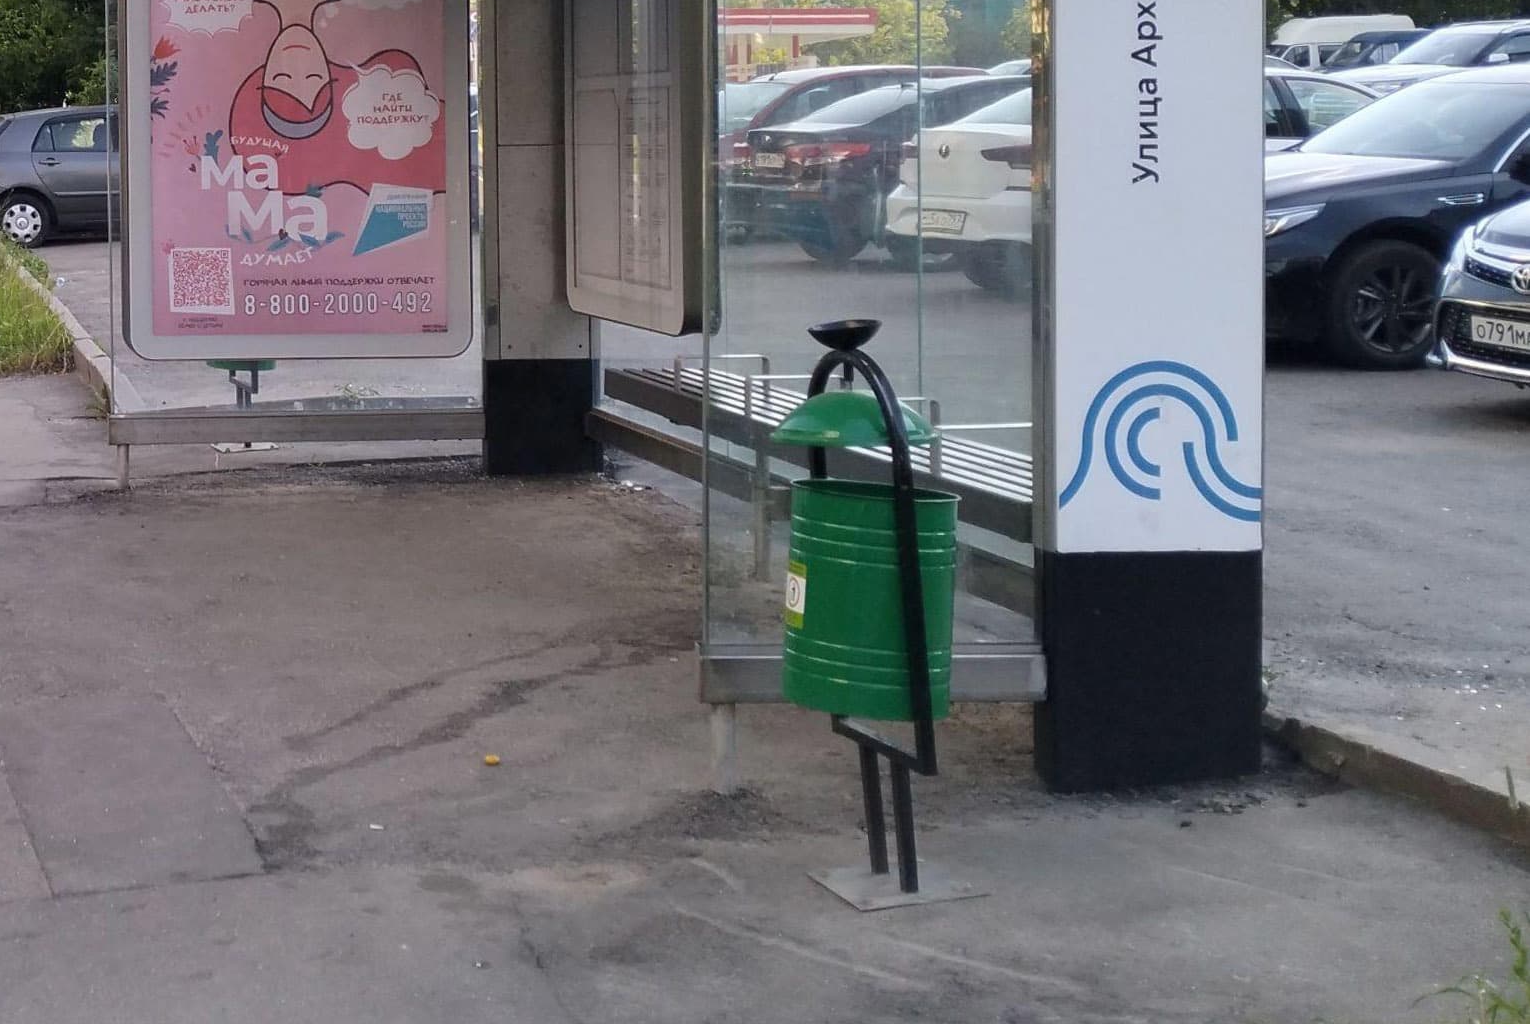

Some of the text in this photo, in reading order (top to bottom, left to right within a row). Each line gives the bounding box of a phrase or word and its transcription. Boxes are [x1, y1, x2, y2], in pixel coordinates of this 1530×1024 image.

[184, 4, 236, 14] ДЕЛАТЬ?
[382, 93, 403, 104] ГДЕ
[1131, 78, 1162, 183] Улица
[240, 246, 314, 266] ДУМАЕТ
[387, 276, 435, 285] ОТВЕЧАЕТ
[244, 291, 432, 315] 8-800-2000-492
[1476, 321, 1530, 345] О791М
